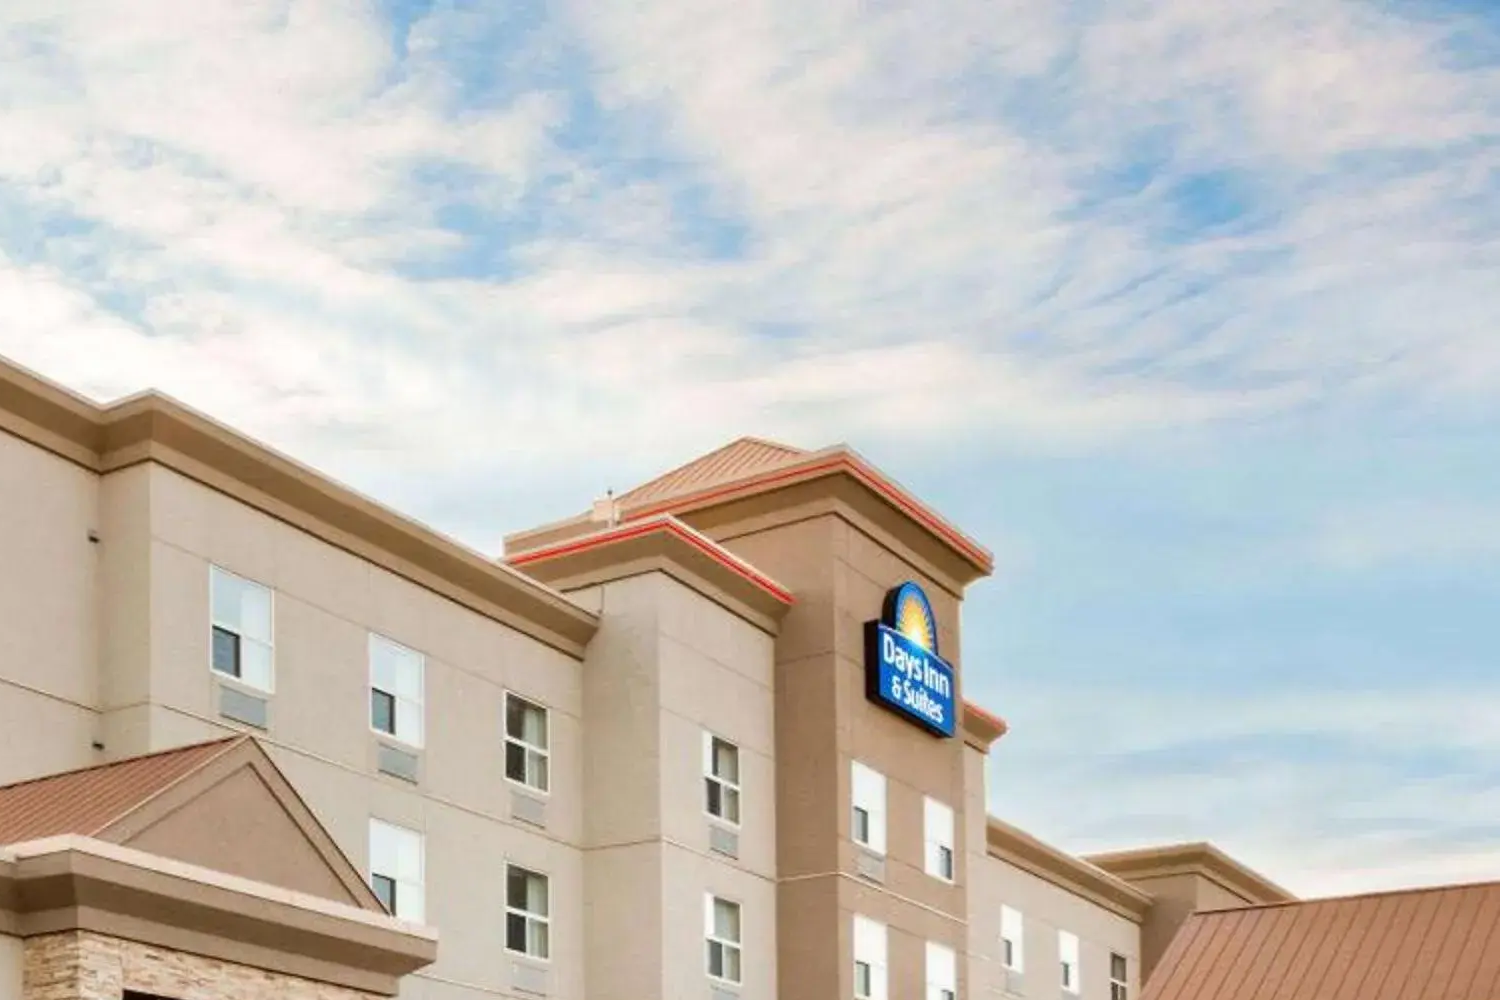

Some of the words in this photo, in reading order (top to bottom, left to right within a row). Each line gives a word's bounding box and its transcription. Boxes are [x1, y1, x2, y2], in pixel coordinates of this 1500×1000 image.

[882, 632, 922, 681] Days
[923, 658, 950, 698] Inn
[891, 675, 902, 700] &
[903, 678, 945, 724] Suites
